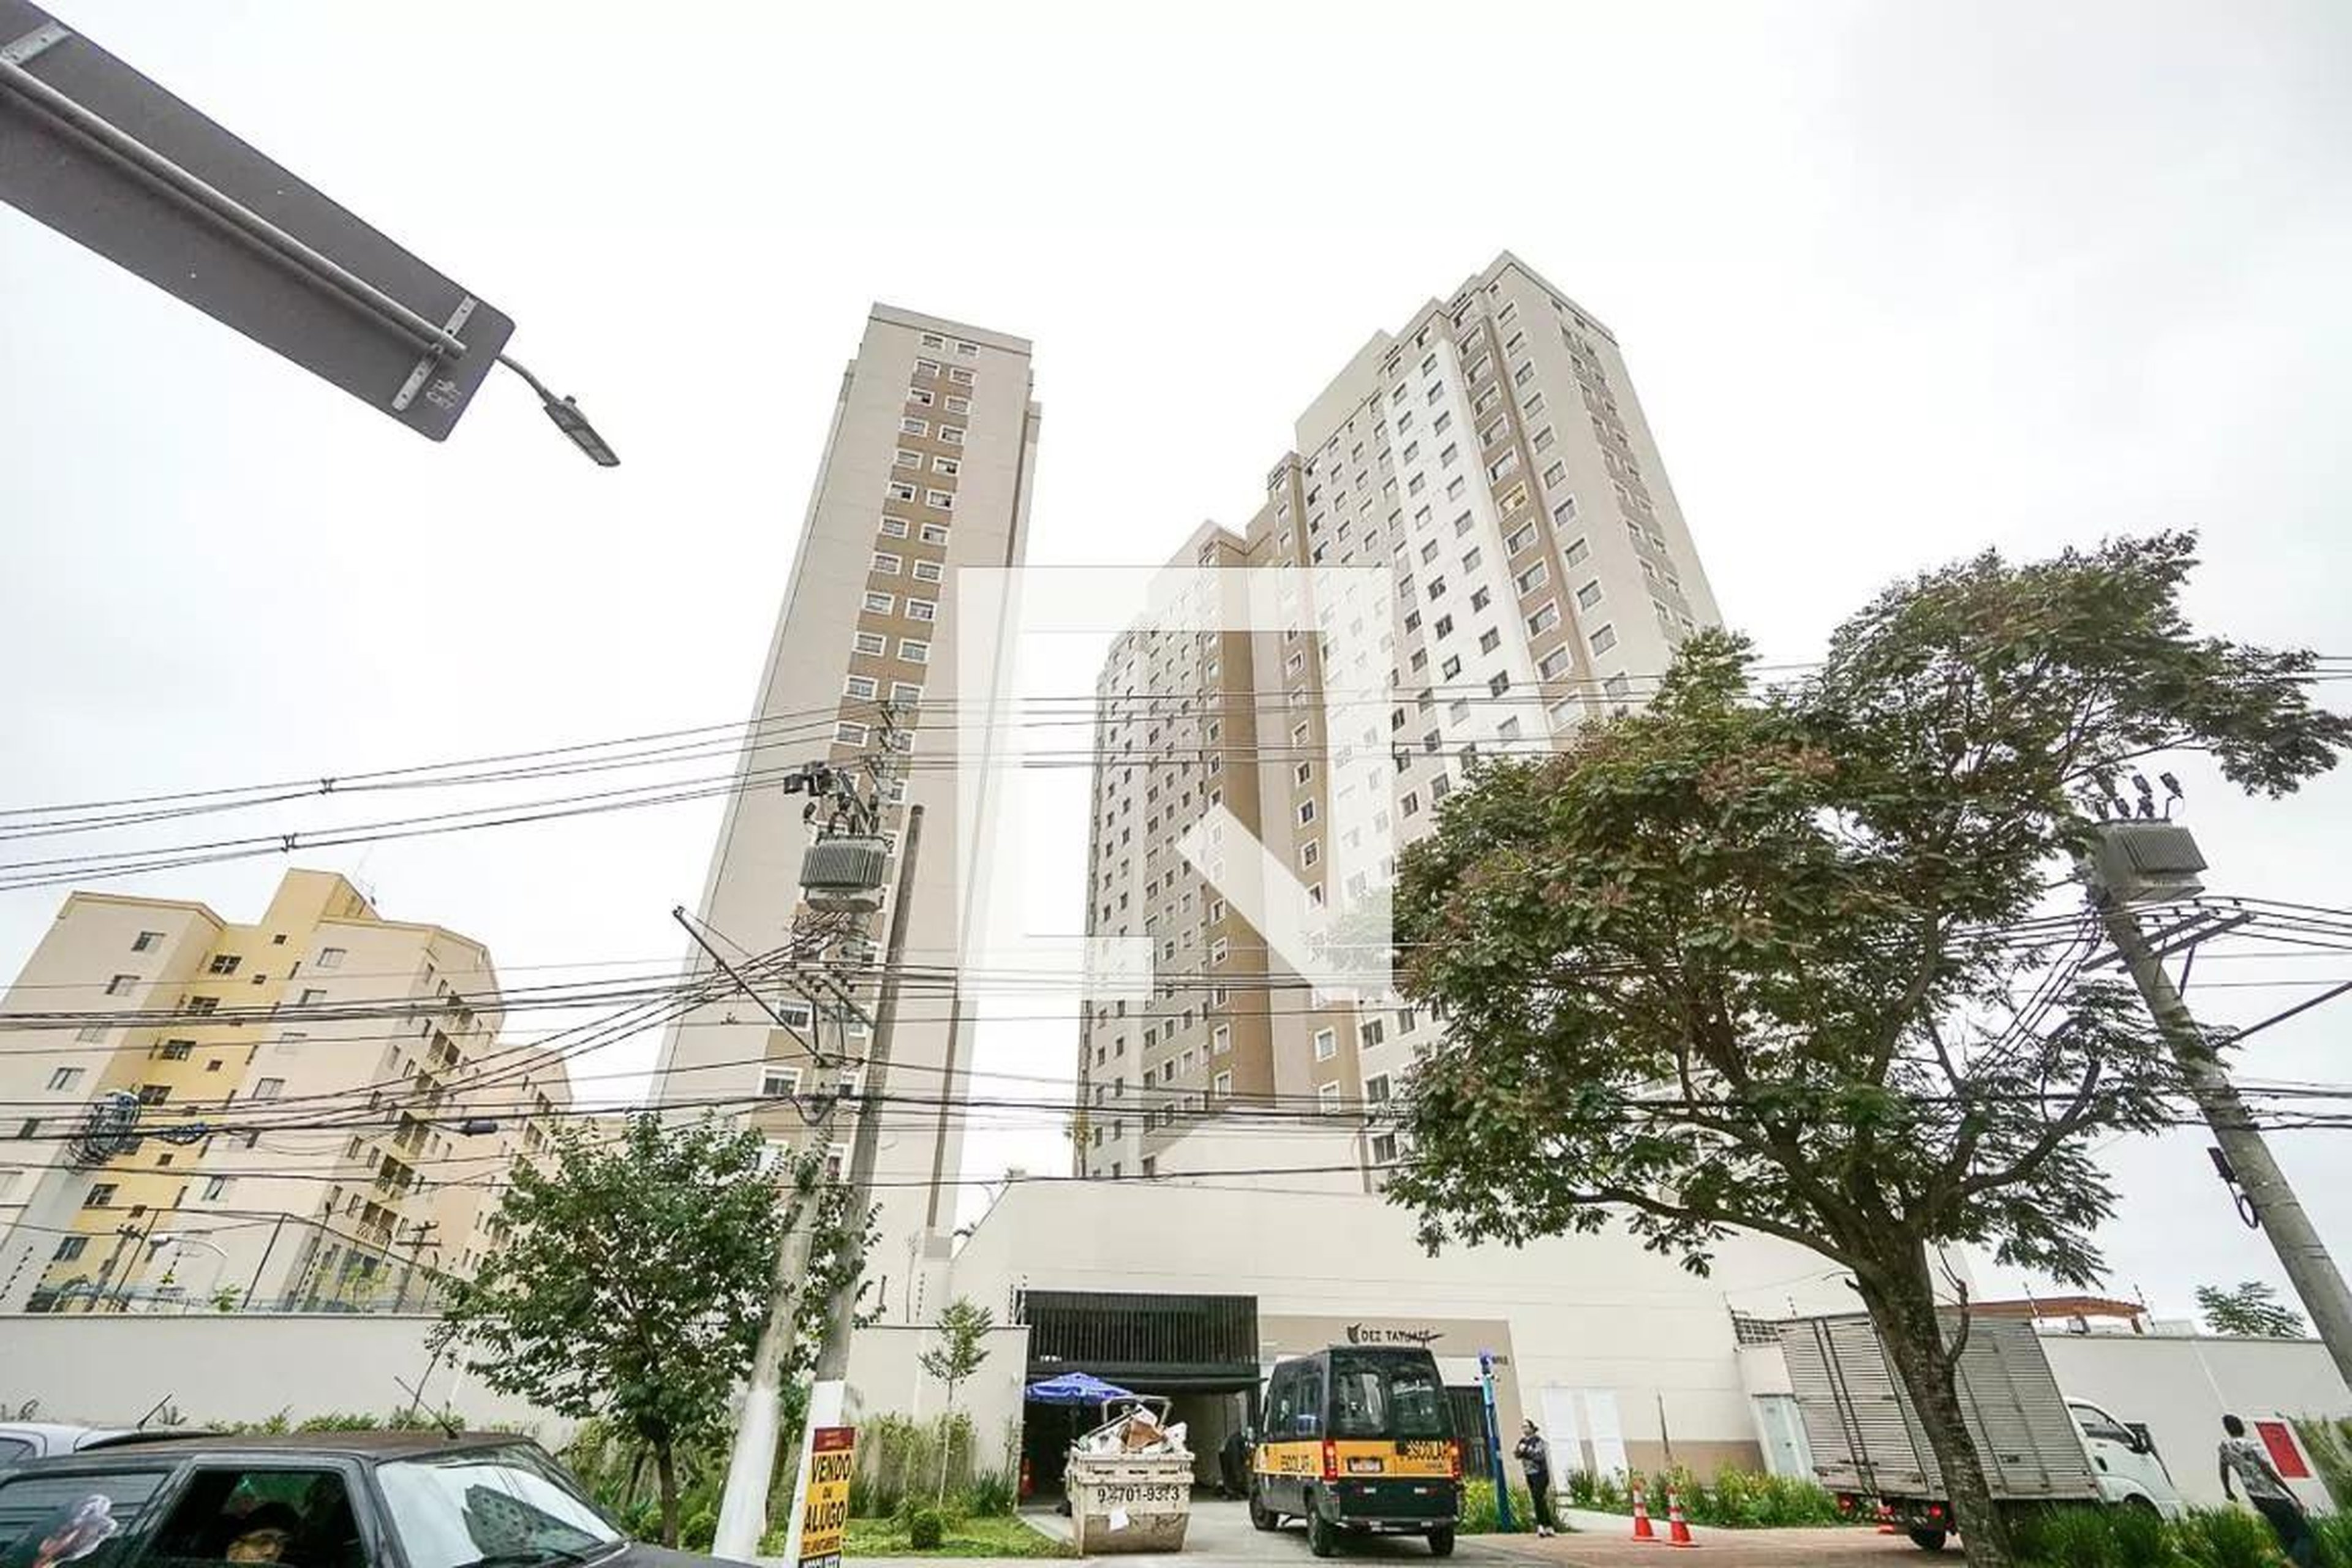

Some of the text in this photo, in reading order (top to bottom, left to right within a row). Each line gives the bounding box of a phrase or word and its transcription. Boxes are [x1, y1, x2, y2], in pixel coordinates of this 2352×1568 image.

[1362, 1330, 1381, 1342] DEZ
[812, 1453, 852, 1483] VENDO
[803, 1501, 846, 1535] ALUGO
